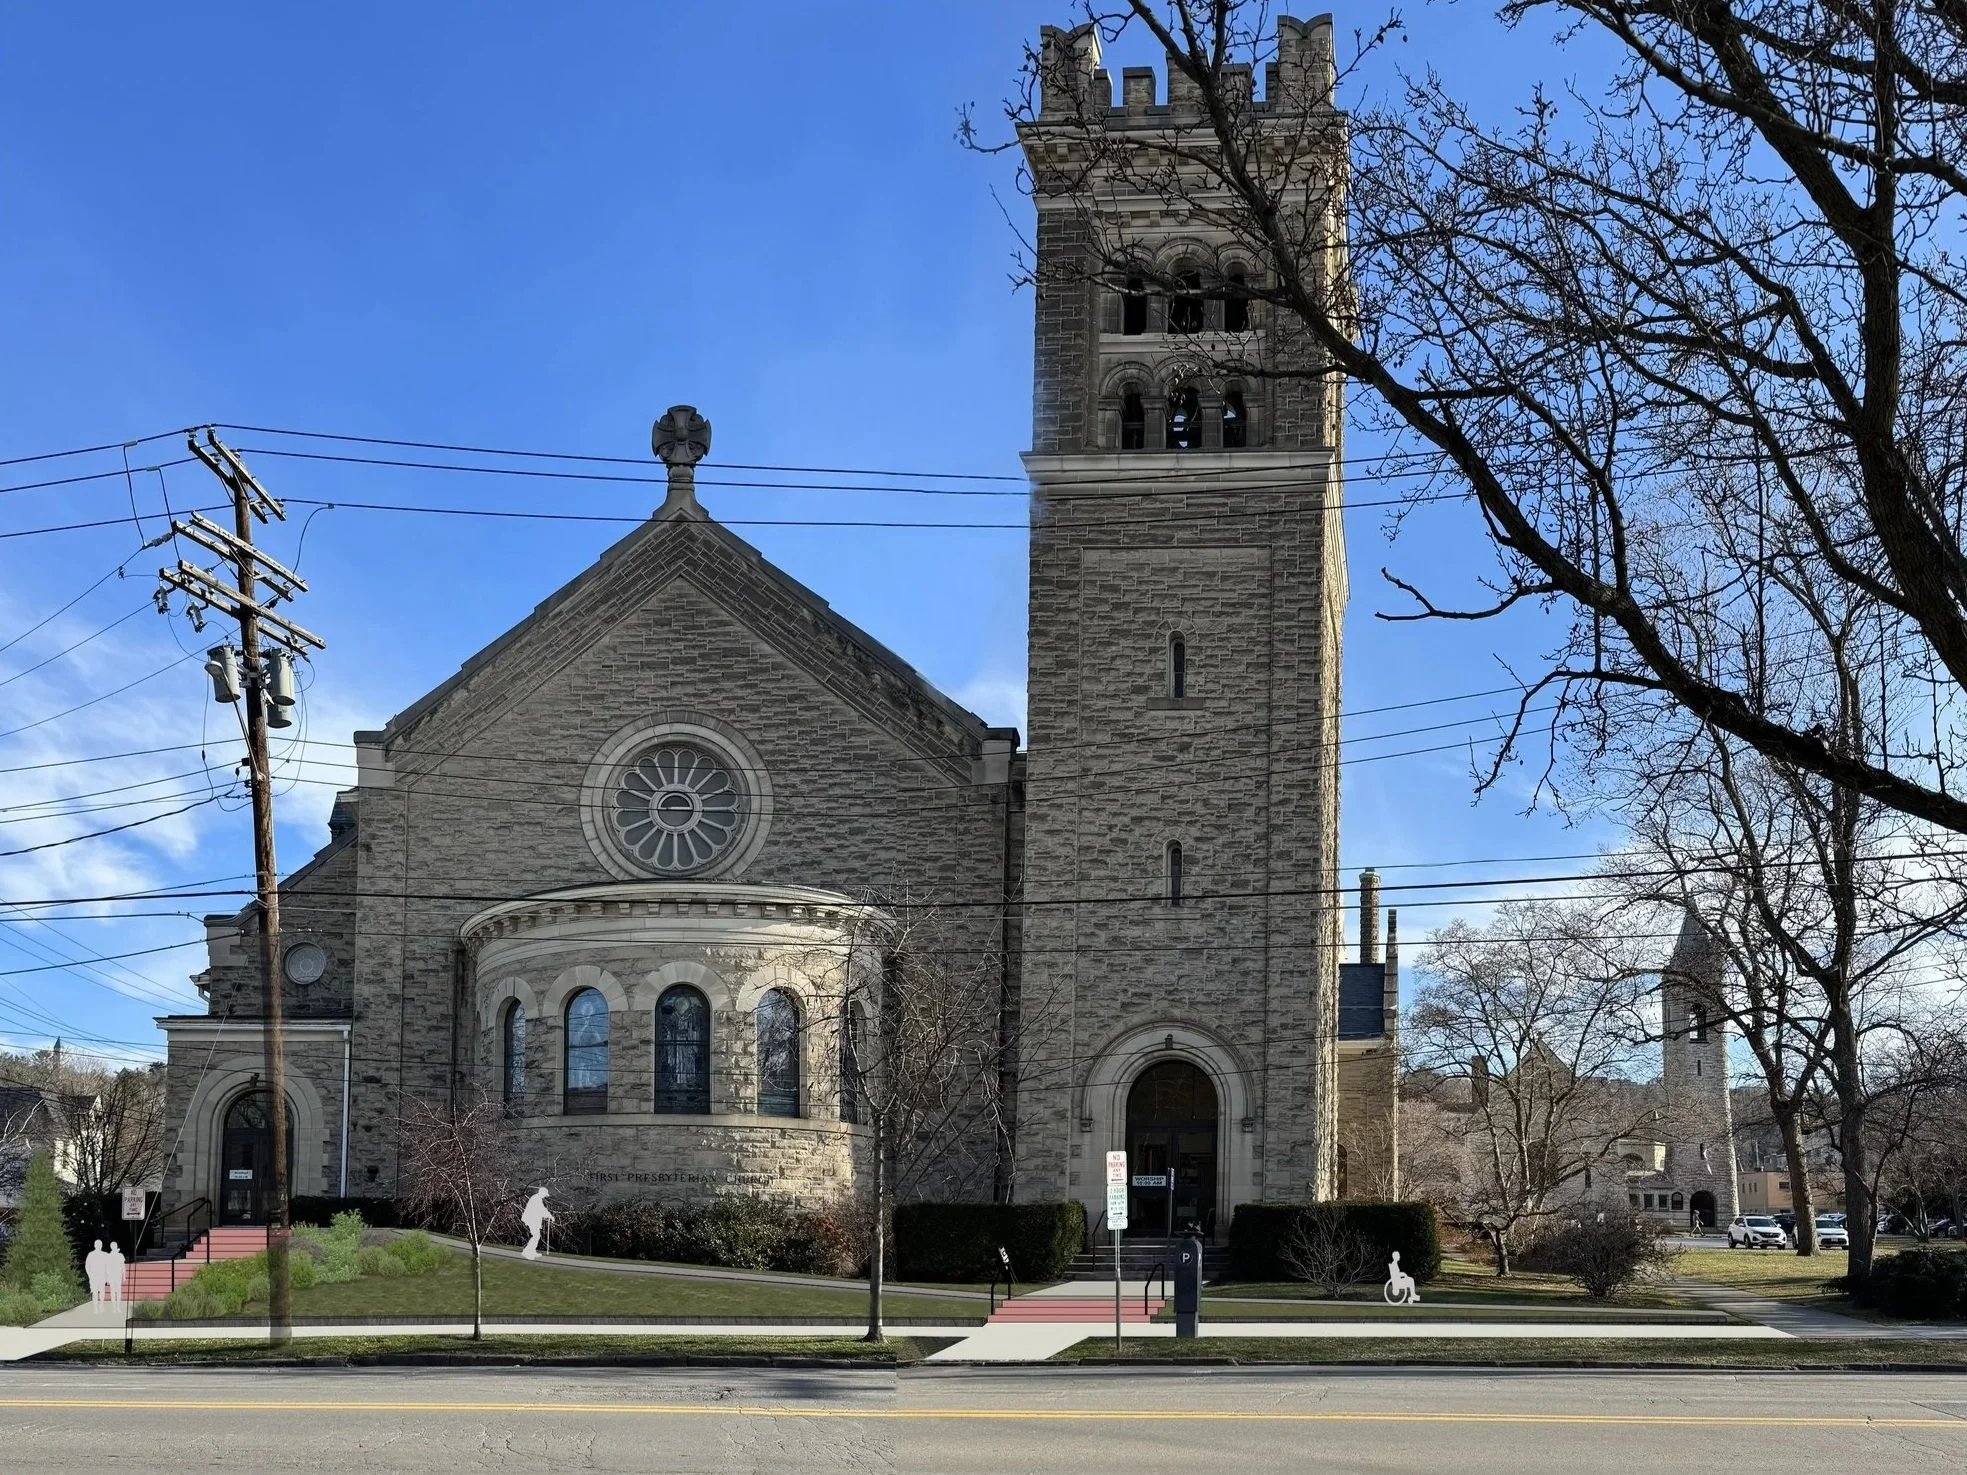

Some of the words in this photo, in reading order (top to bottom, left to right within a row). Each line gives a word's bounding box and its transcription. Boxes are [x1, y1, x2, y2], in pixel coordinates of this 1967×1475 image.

[590, 1173, 620, 1183] FIRST
[627, 1172, 717, 1184] PRESBYTERIAN
[725, 1174, 775, 1186] CHURCH
[1182, 1252, 1190, 1263] P
